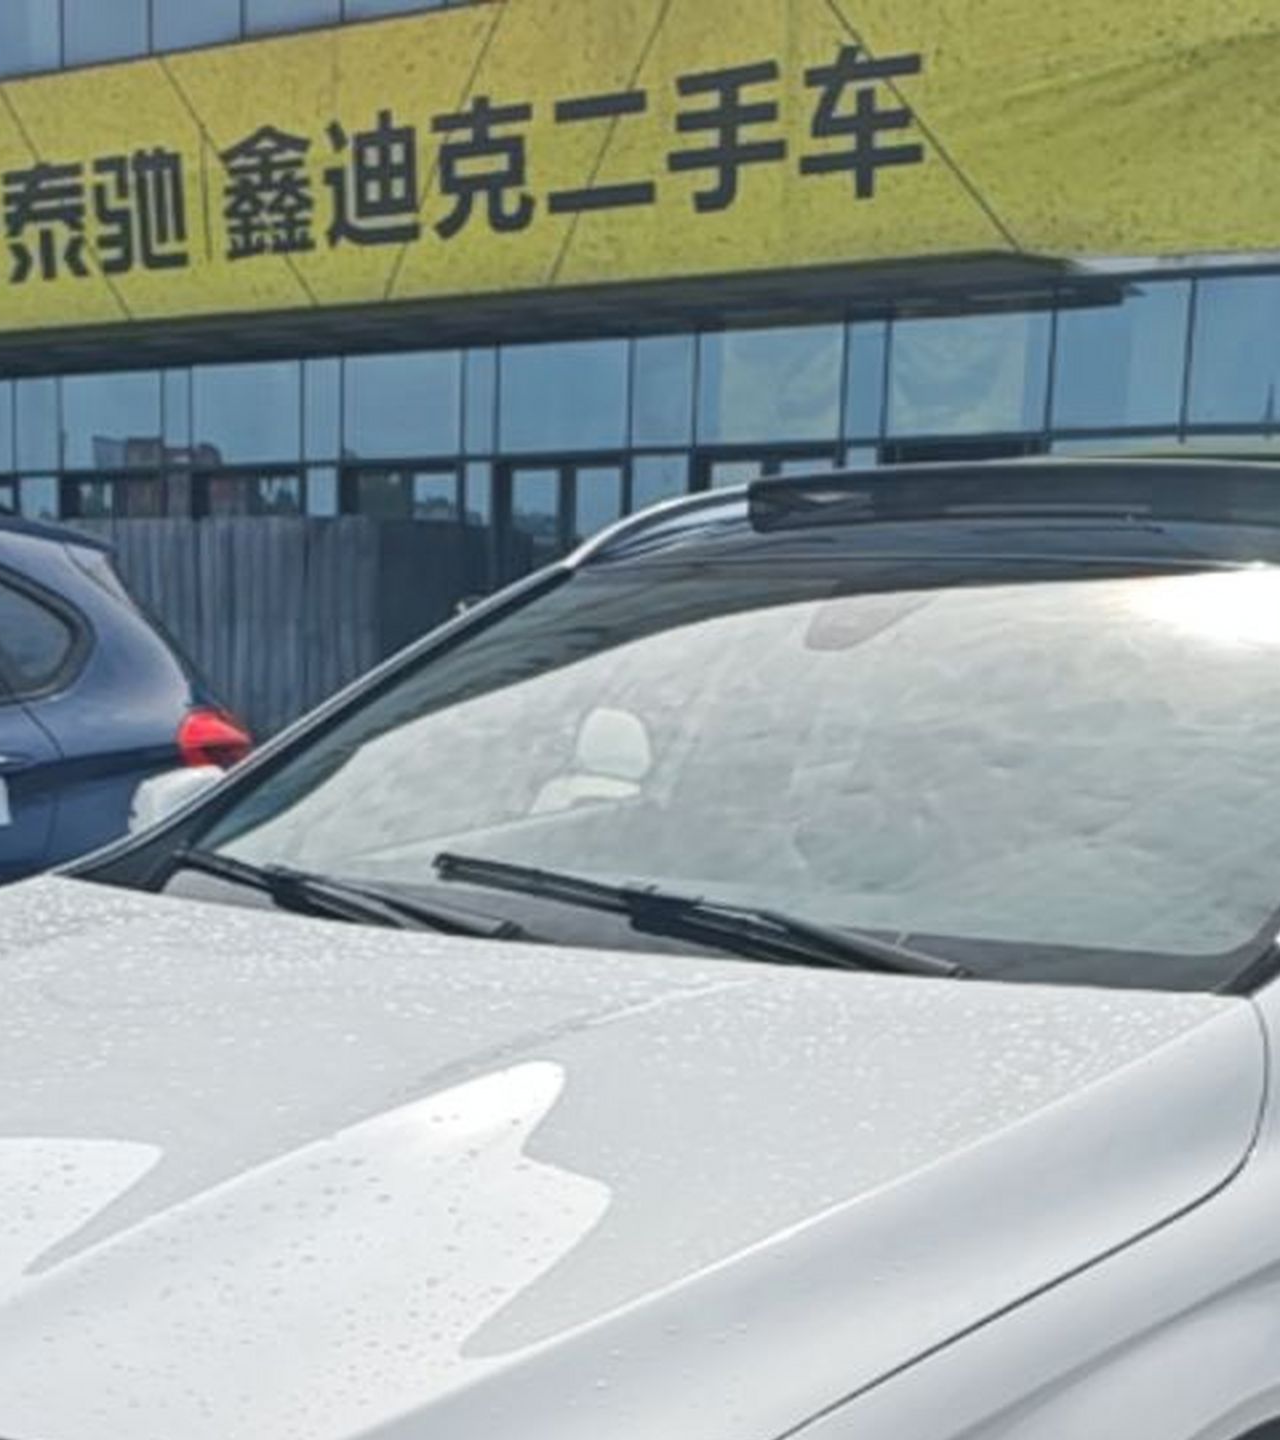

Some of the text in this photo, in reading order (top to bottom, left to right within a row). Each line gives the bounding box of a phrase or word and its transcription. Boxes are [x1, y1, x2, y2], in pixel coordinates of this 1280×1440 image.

[222, 44, 925, 262] 鑫迪克二手车
